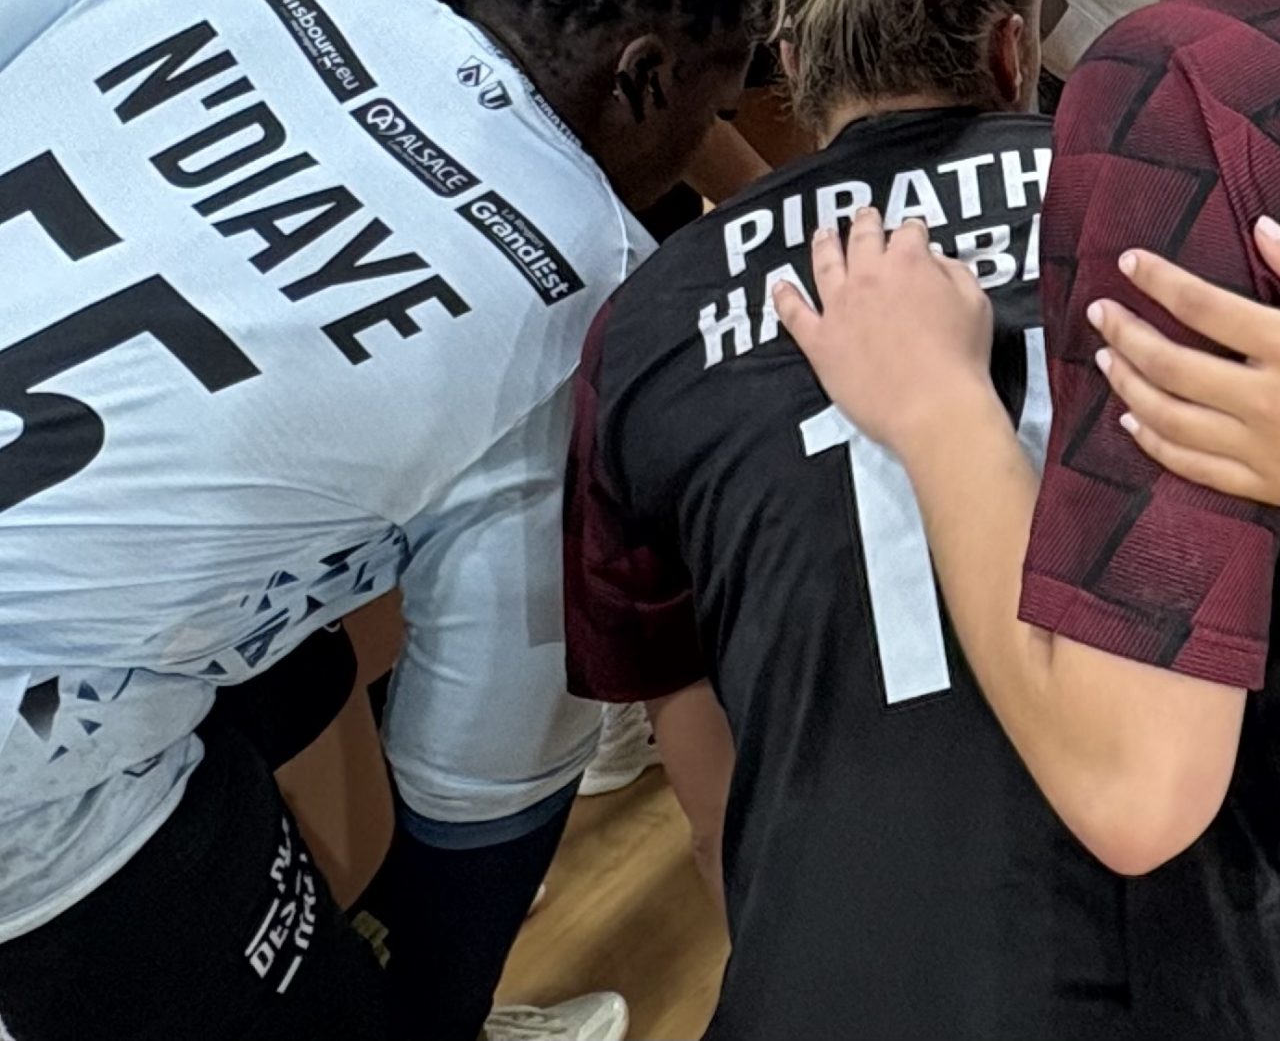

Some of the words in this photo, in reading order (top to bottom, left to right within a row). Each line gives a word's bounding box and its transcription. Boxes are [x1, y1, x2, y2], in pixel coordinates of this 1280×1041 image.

[94, 19, 473, 366] N'DIAYE
[394, 134, 470, 190] ALSACE
[723, 148, 1053, 278] PIRATH
